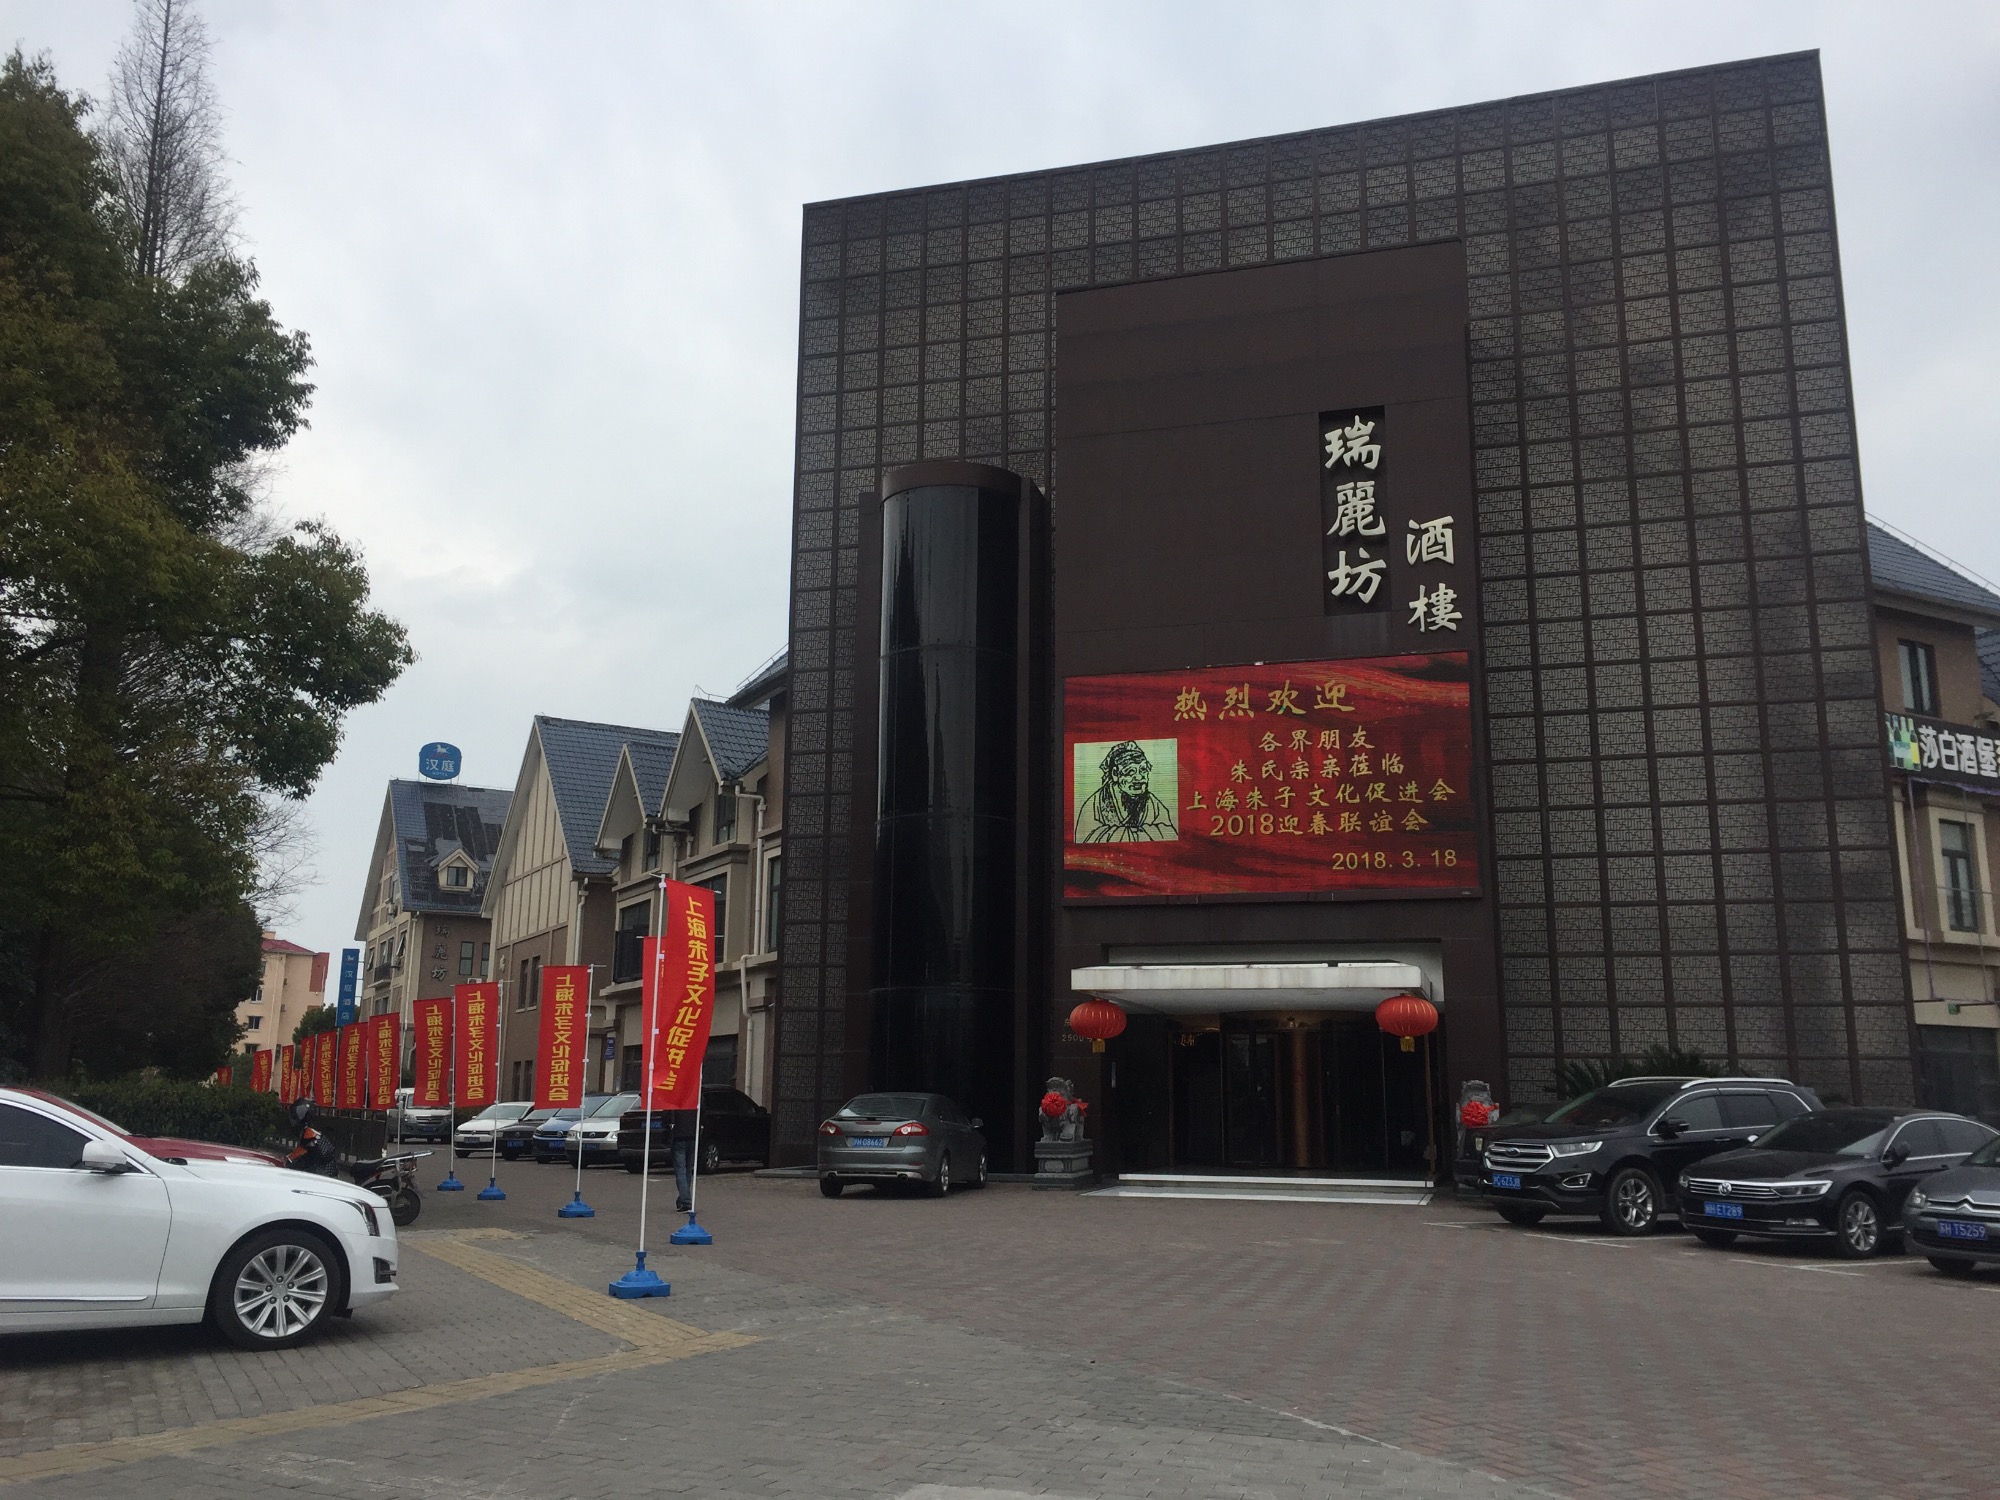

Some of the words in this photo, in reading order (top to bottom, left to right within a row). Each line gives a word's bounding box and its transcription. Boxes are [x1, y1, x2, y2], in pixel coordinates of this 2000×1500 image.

[1324, 414, 1387, 604] 瑞麗坊
[1406, 515, 1463, 633] 酒樓
[1173, 679, 1356, 722] 热烈欢迎
[1258, 725, 1375, 753] 各界朋友
[426, 758, 455, 773] 汉庭
[1230, 753, 1405, 785] 朱氏宗亲莅临
[1186, 777, 1456, 812] 上海朱子文化促进会
[1210, 808, 1429, 838] 2018迎春联谊会
